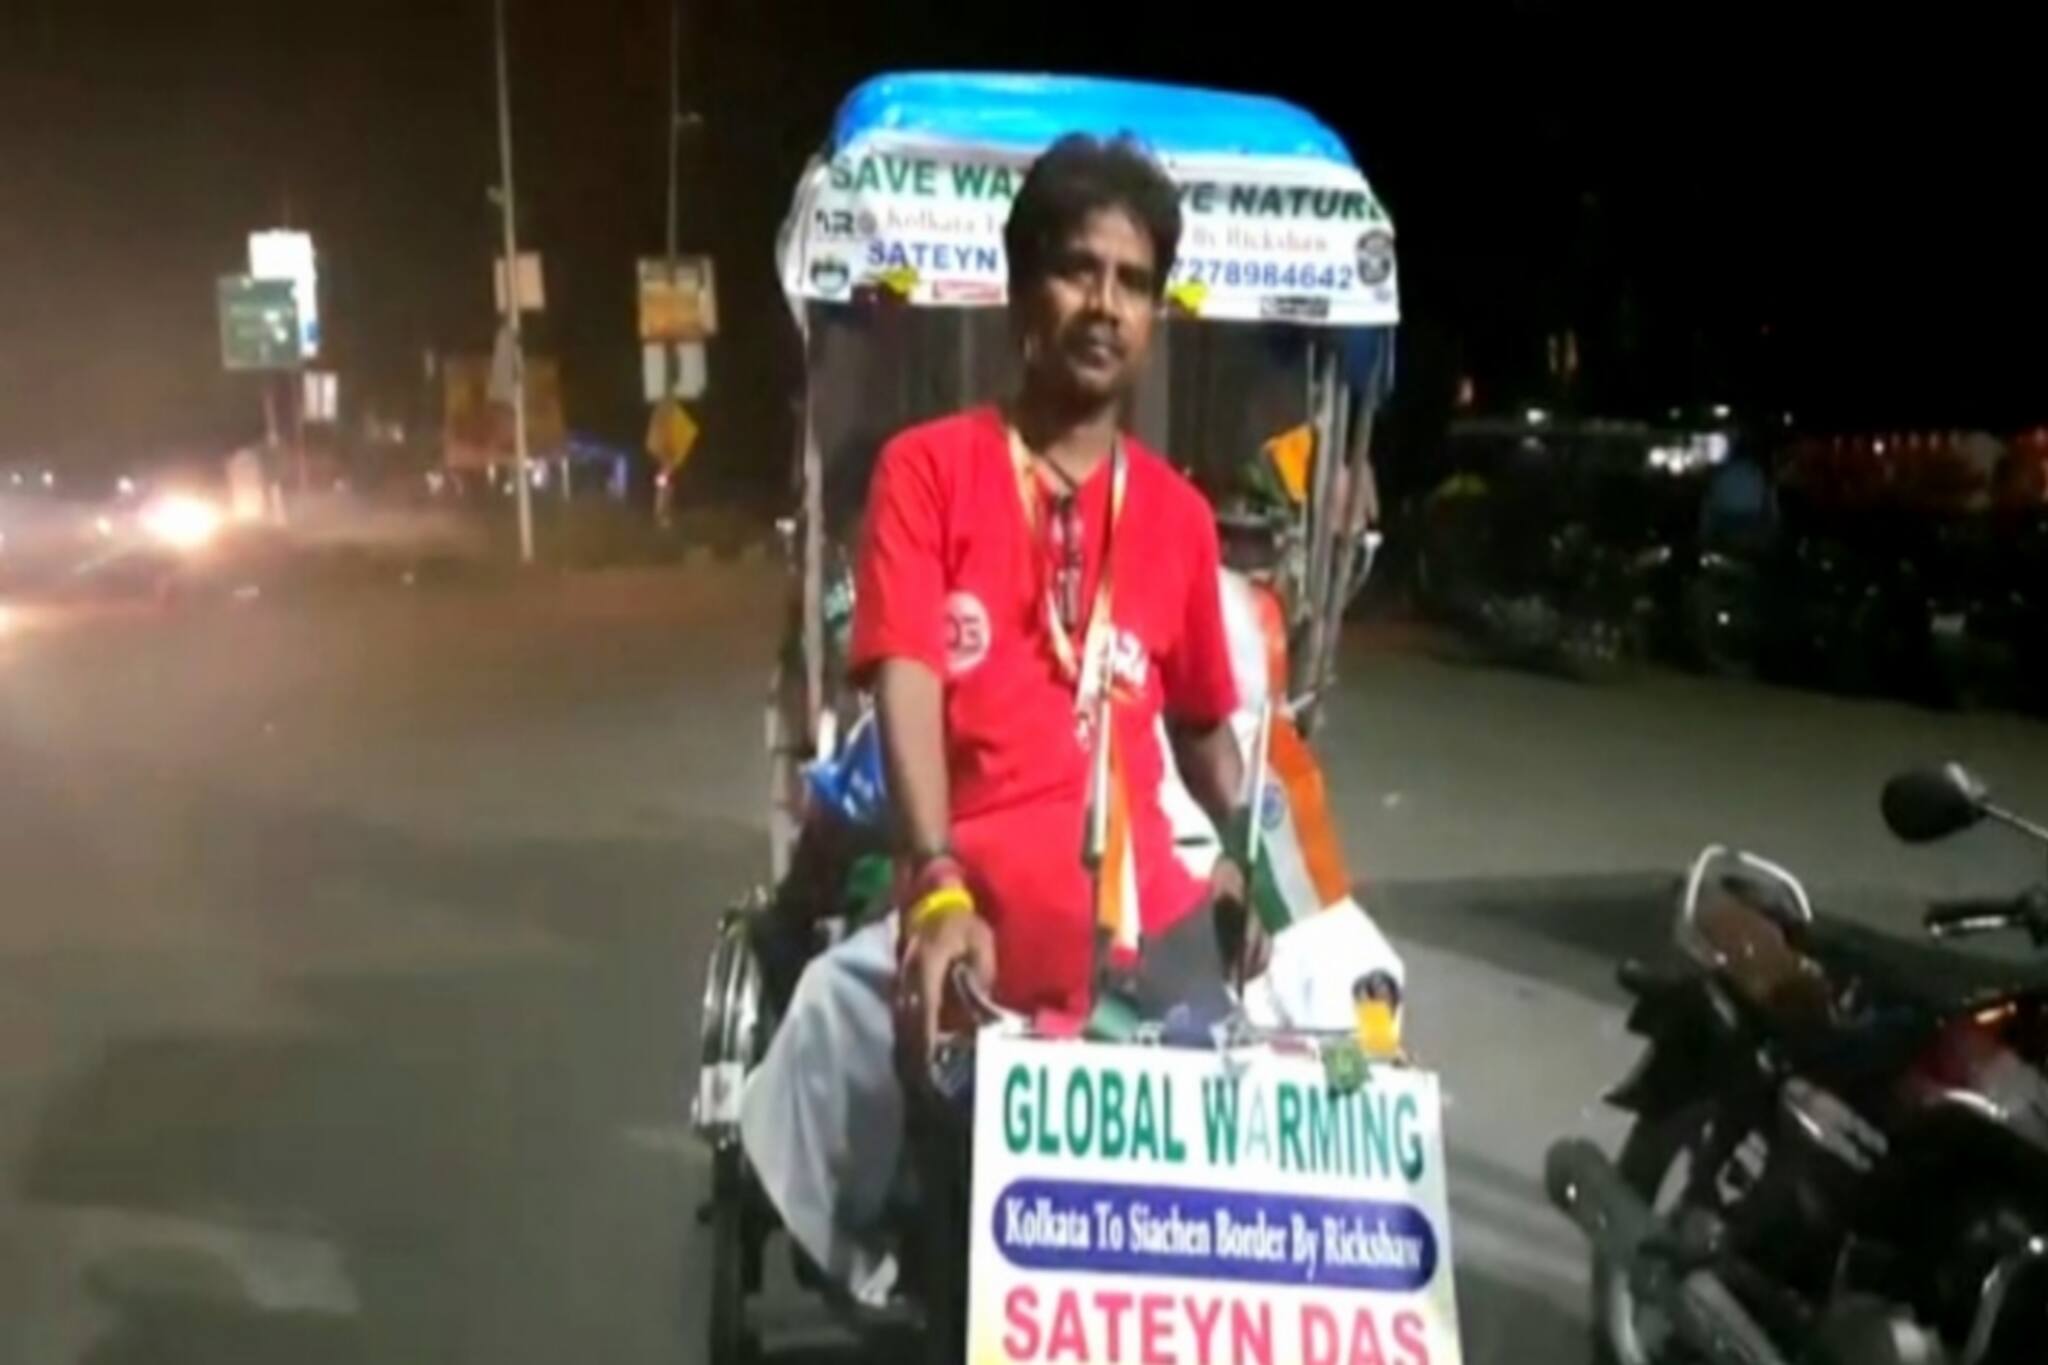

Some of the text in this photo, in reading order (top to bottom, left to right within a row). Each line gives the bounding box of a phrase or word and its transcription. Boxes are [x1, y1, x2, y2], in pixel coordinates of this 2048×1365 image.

[830, 154, 936, 196] SAVE
[867, 240, 998, 271] SATEYN
[1003, 1063, 1424, 1183] GLOBAL WARMING
[1004, 1196, 1423, 1282] Kolkata To Siachen Border By Rickshaw
[1002, 1285, 1431, 1365] SATEYN DAS
